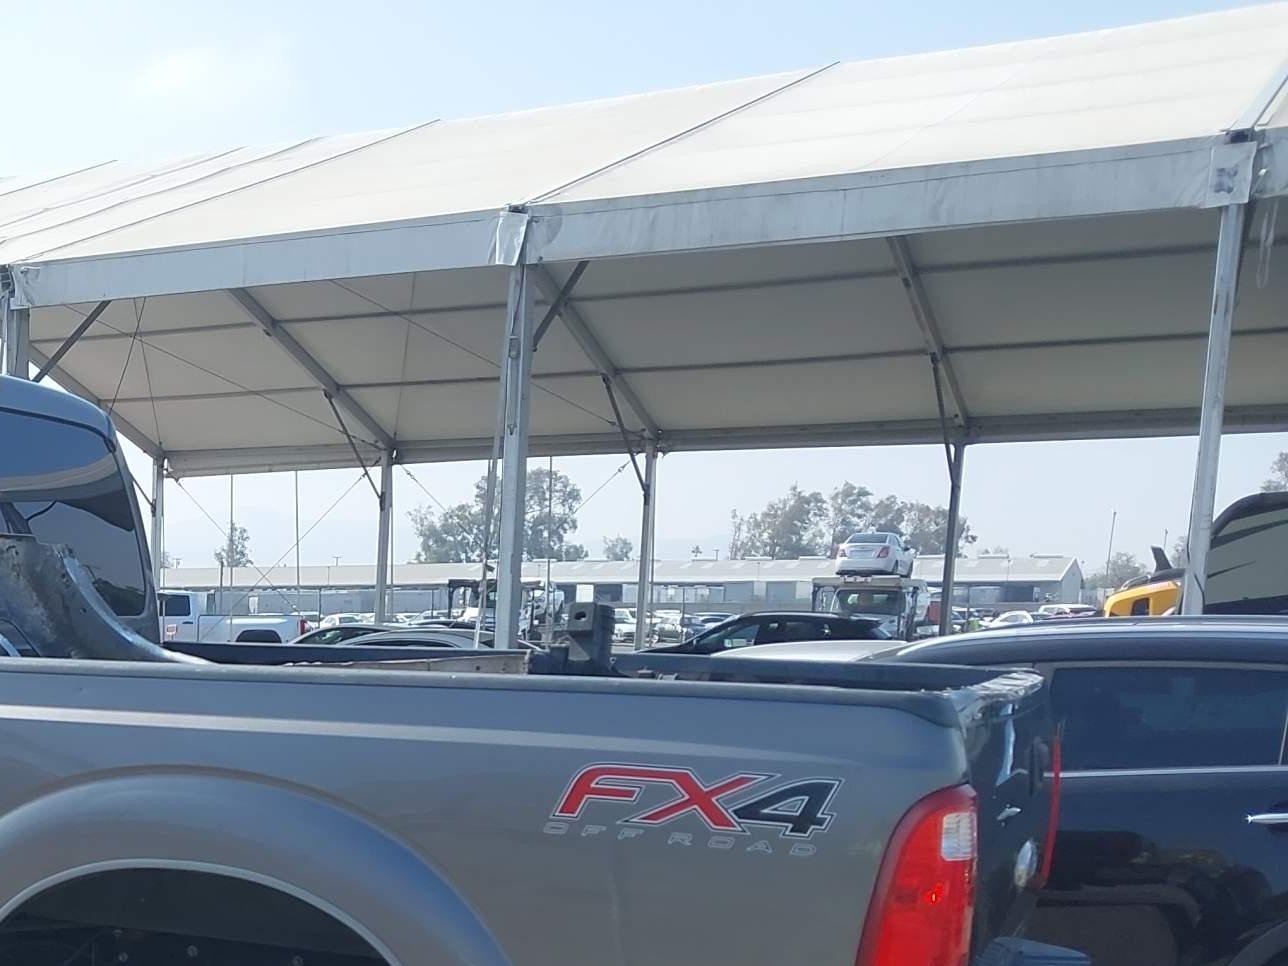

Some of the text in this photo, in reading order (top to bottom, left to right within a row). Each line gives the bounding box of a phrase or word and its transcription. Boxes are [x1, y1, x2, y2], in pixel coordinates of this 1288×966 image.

[549, 761, 845, 840] FX4
[543, 821, 817, 857] OFF ROAD
